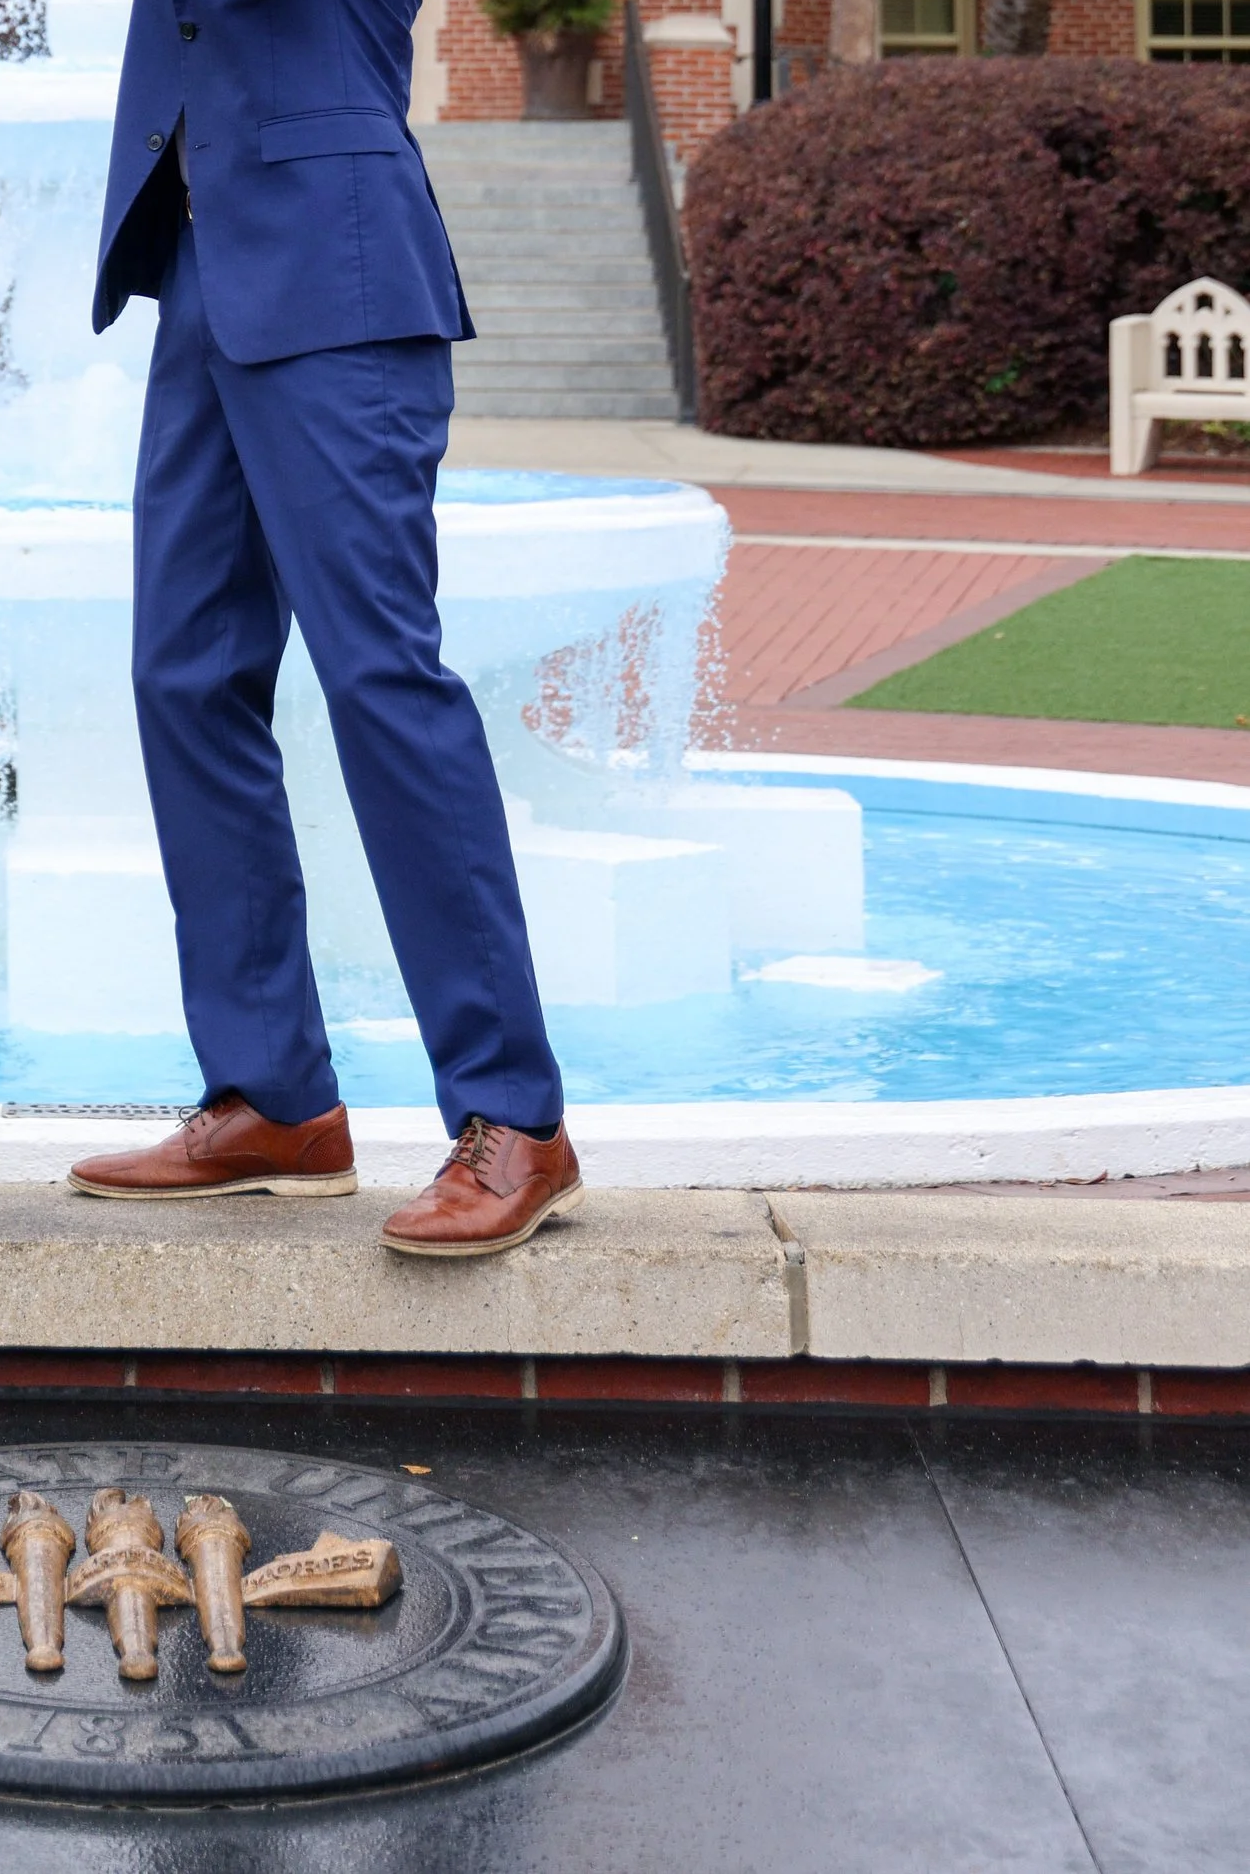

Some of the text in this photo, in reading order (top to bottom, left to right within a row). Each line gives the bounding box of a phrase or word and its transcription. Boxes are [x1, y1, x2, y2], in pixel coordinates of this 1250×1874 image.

[243, 1549, 375, 1590] MORES
[267, 1459, 585, 1726] UNIVERSITY
[6, 1710, 290, 1764] 1851
